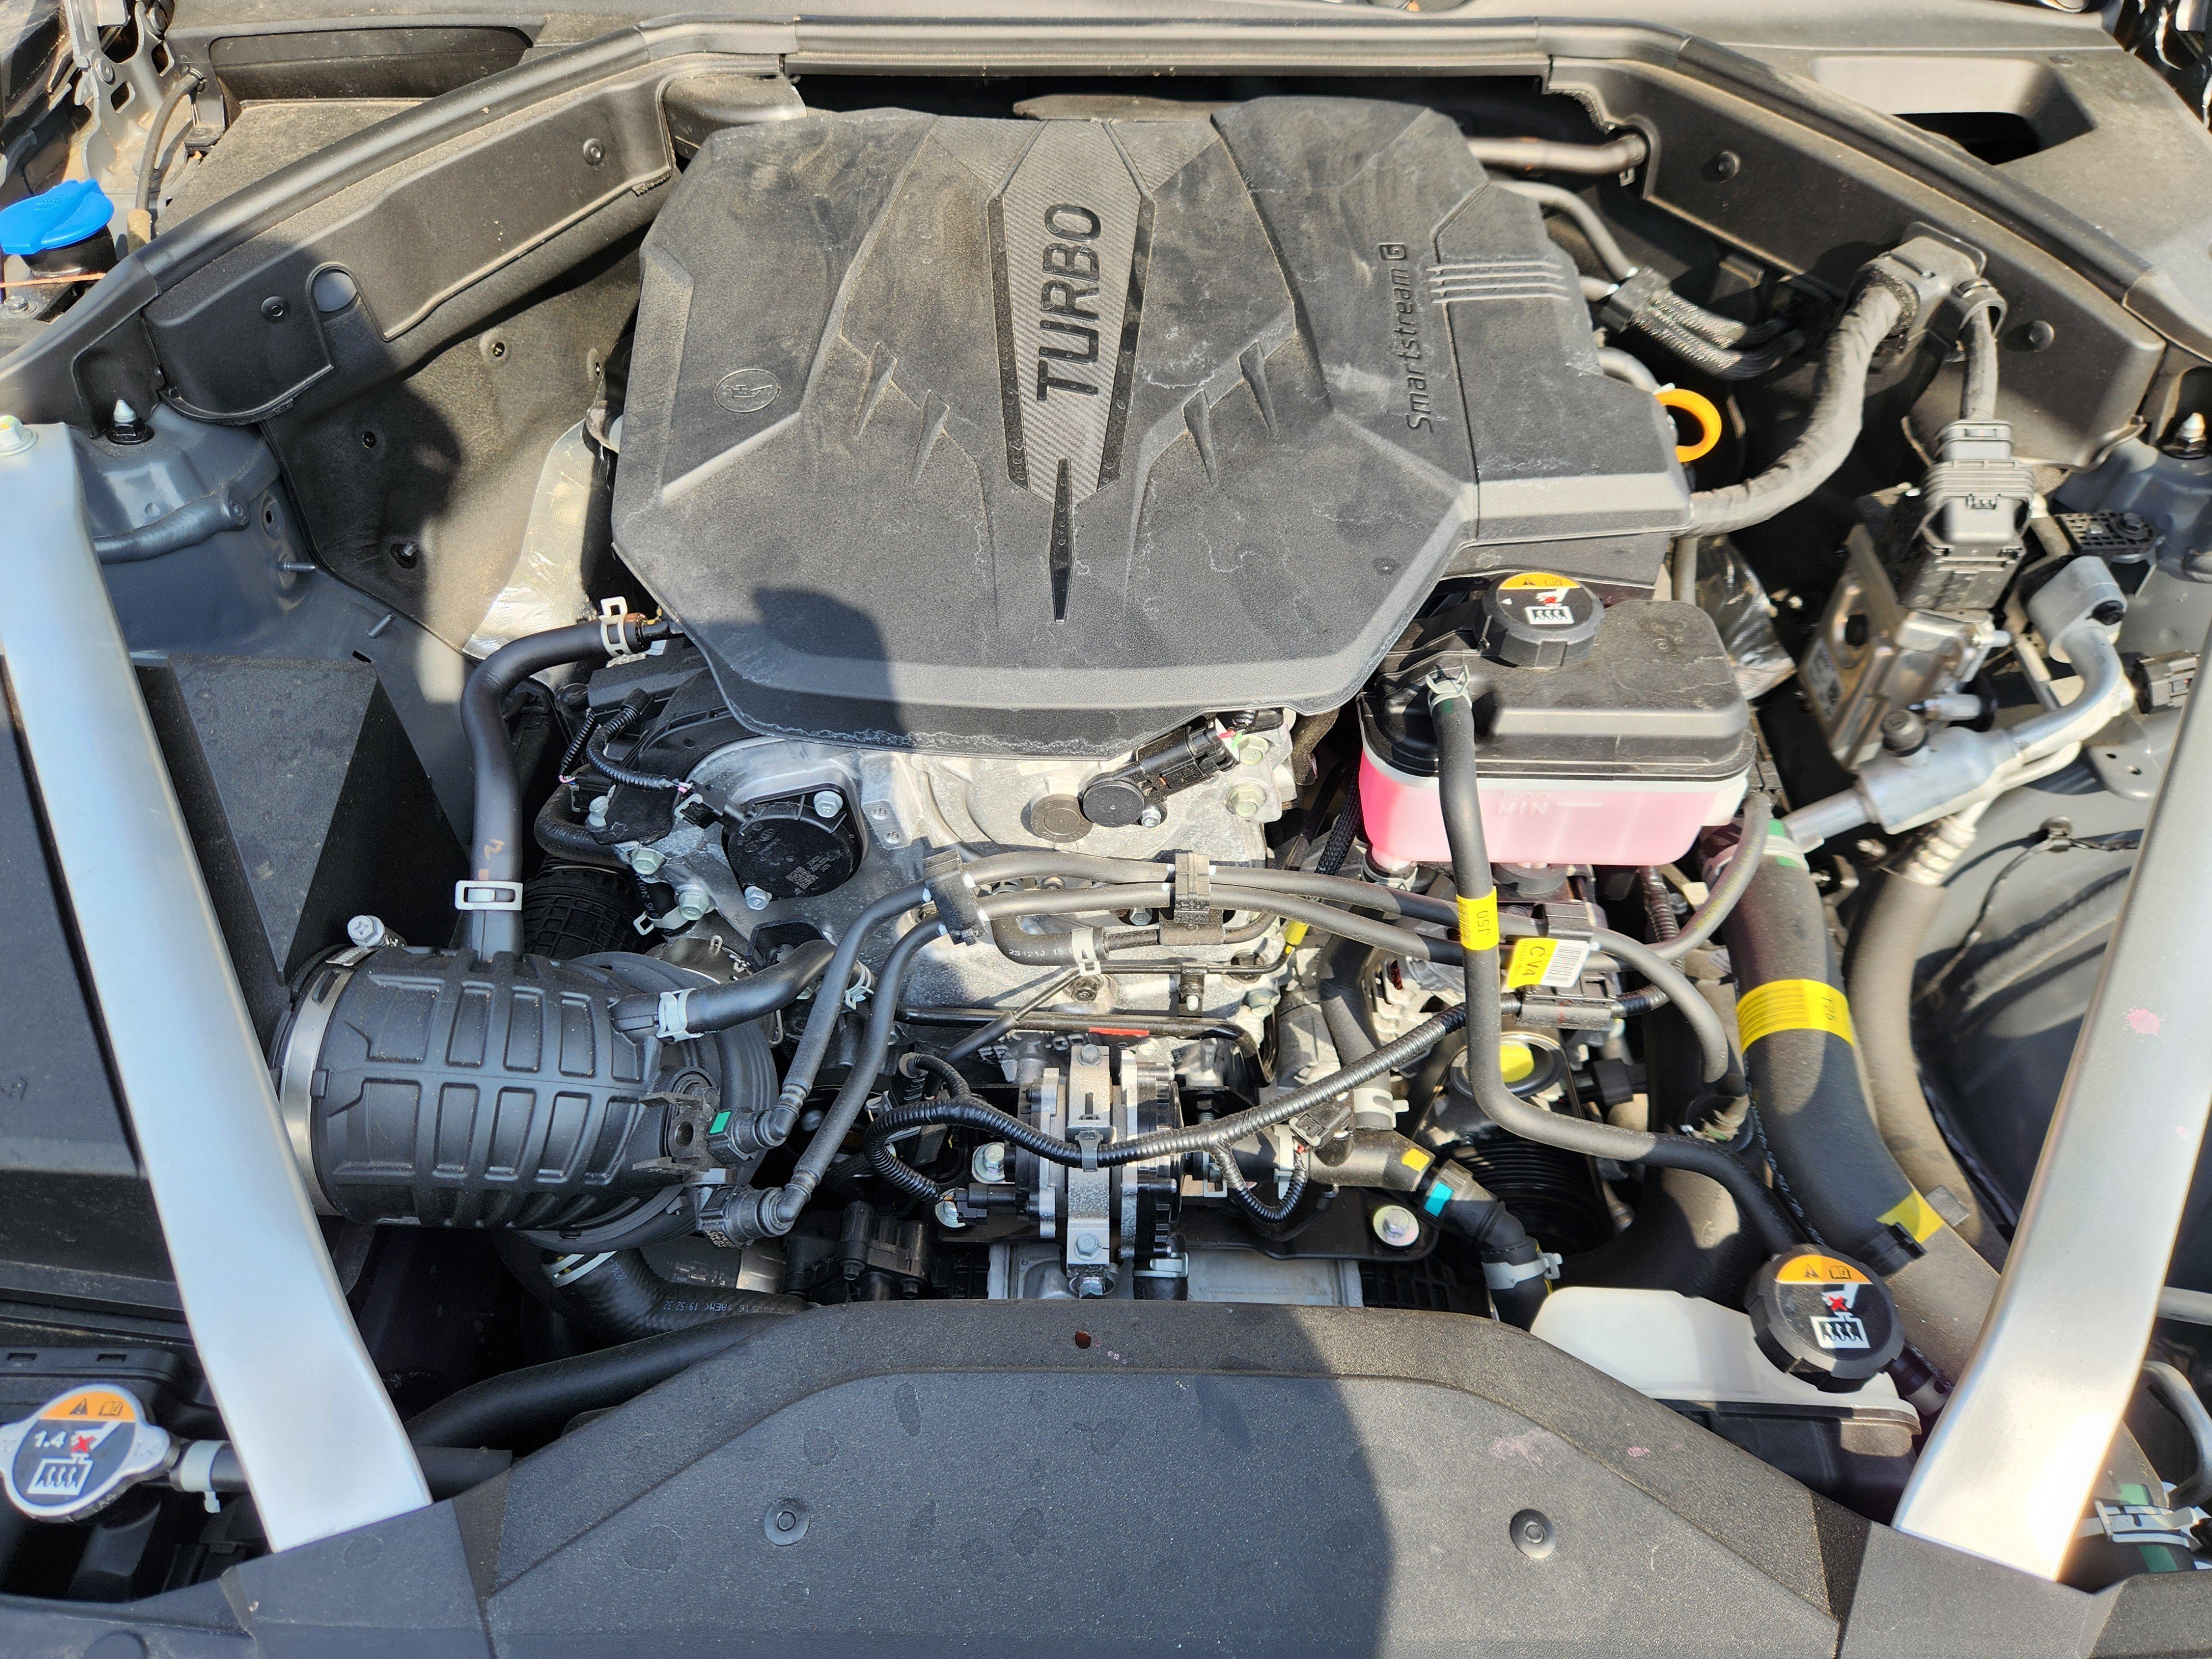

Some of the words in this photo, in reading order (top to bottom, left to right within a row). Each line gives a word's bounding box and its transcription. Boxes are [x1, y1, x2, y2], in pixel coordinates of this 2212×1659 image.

[1037, 204, 1102, 403] TURBO
[1385, 265, 1434, 434] Smartstream
[1496, 801, 1551, 817] MIN
[1478, 910, 1490, 936] J50
[1522, 946, 1546, 977] CV4
[663, 1301, 699, 1311] 19:52:32
[34, 1430, 67, 1448] 1.4
